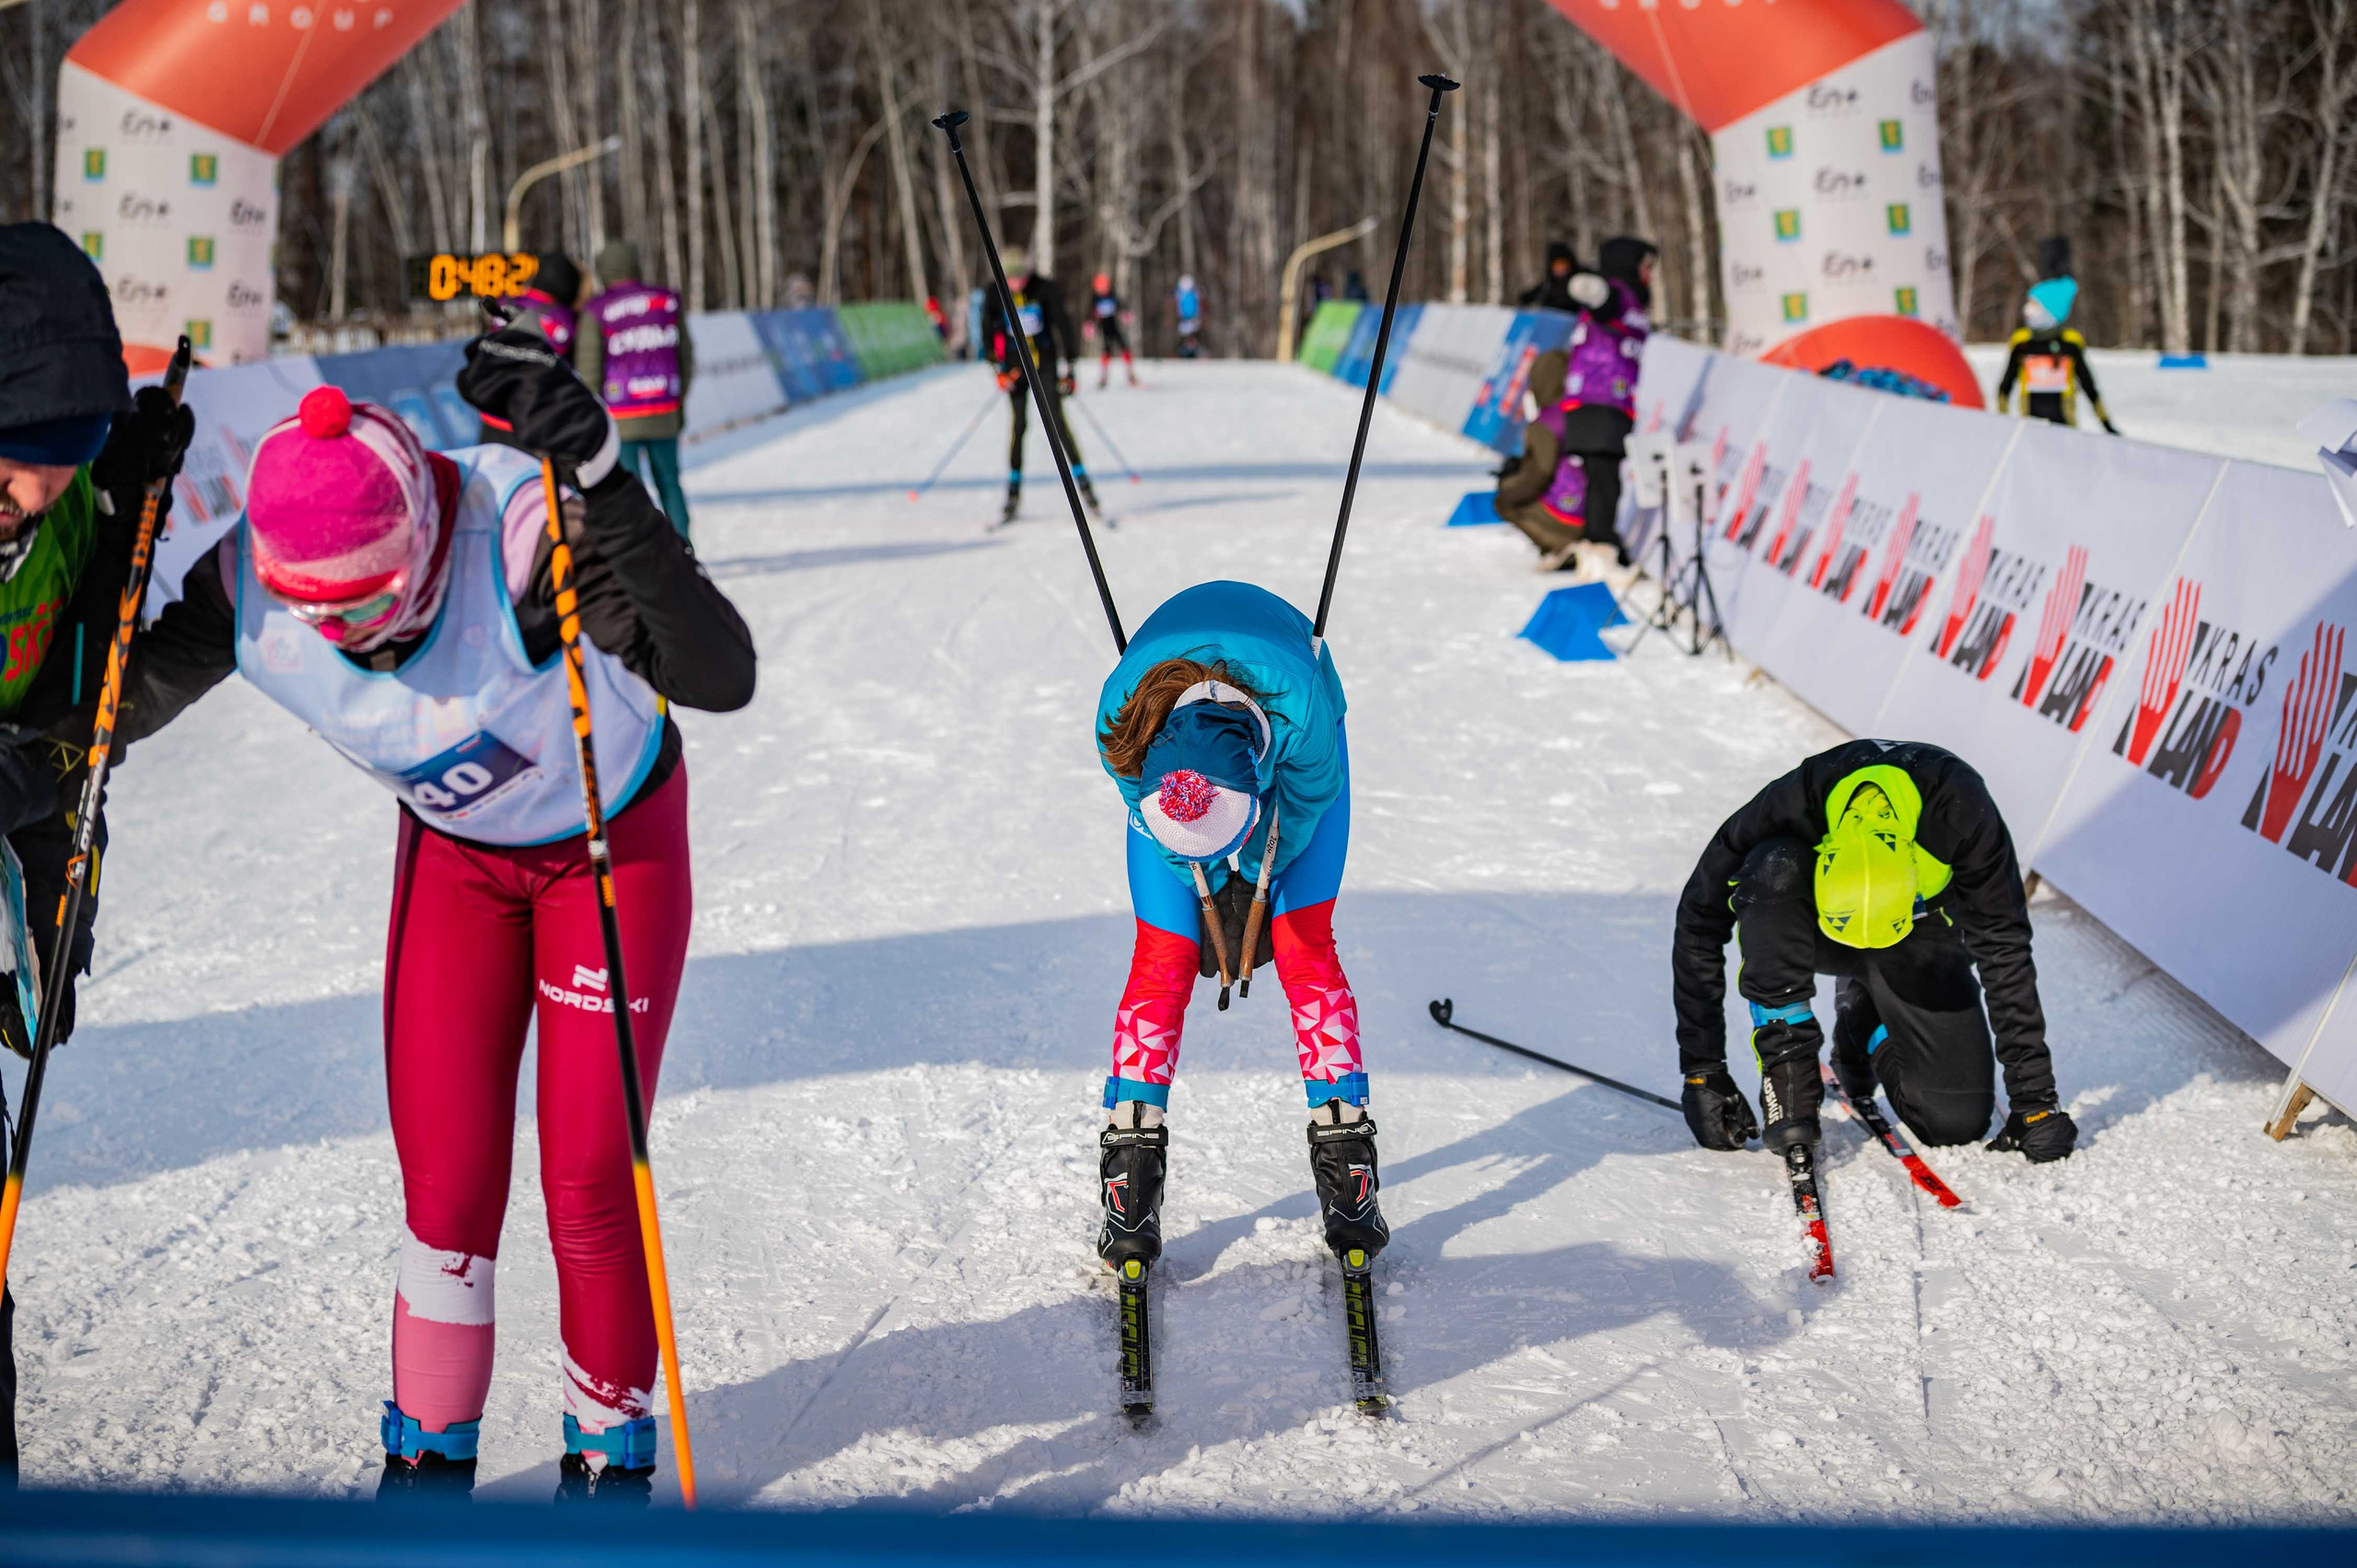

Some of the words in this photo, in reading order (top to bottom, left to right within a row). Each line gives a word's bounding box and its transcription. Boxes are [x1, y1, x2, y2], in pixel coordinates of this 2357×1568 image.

[207, 2, 393, 29] GROUP
[2193, 626, 2279, 707] KRAS
[2146, 689, 2243, 801] LAND
[2286, 751, 2357, 889] LA
